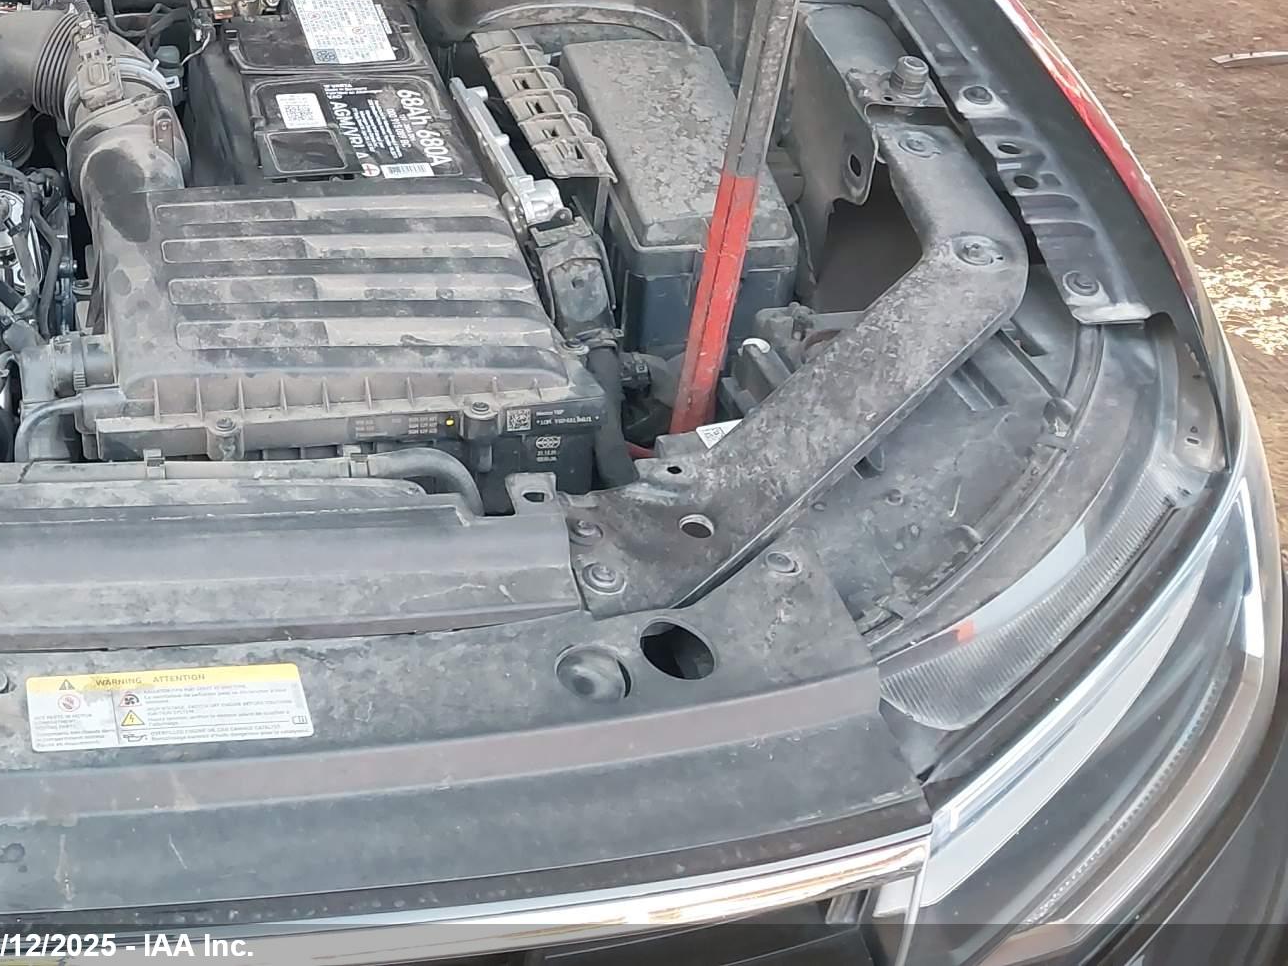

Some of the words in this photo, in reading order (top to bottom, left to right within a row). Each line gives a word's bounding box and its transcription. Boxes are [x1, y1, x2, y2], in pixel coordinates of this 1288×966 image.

[397, 89, 433, 125] 68Ah
[416, 129, 452, 166] 680A
[95, 677, 142, 687] WARNING
[152, 673, 206, 683] ATTENTION
